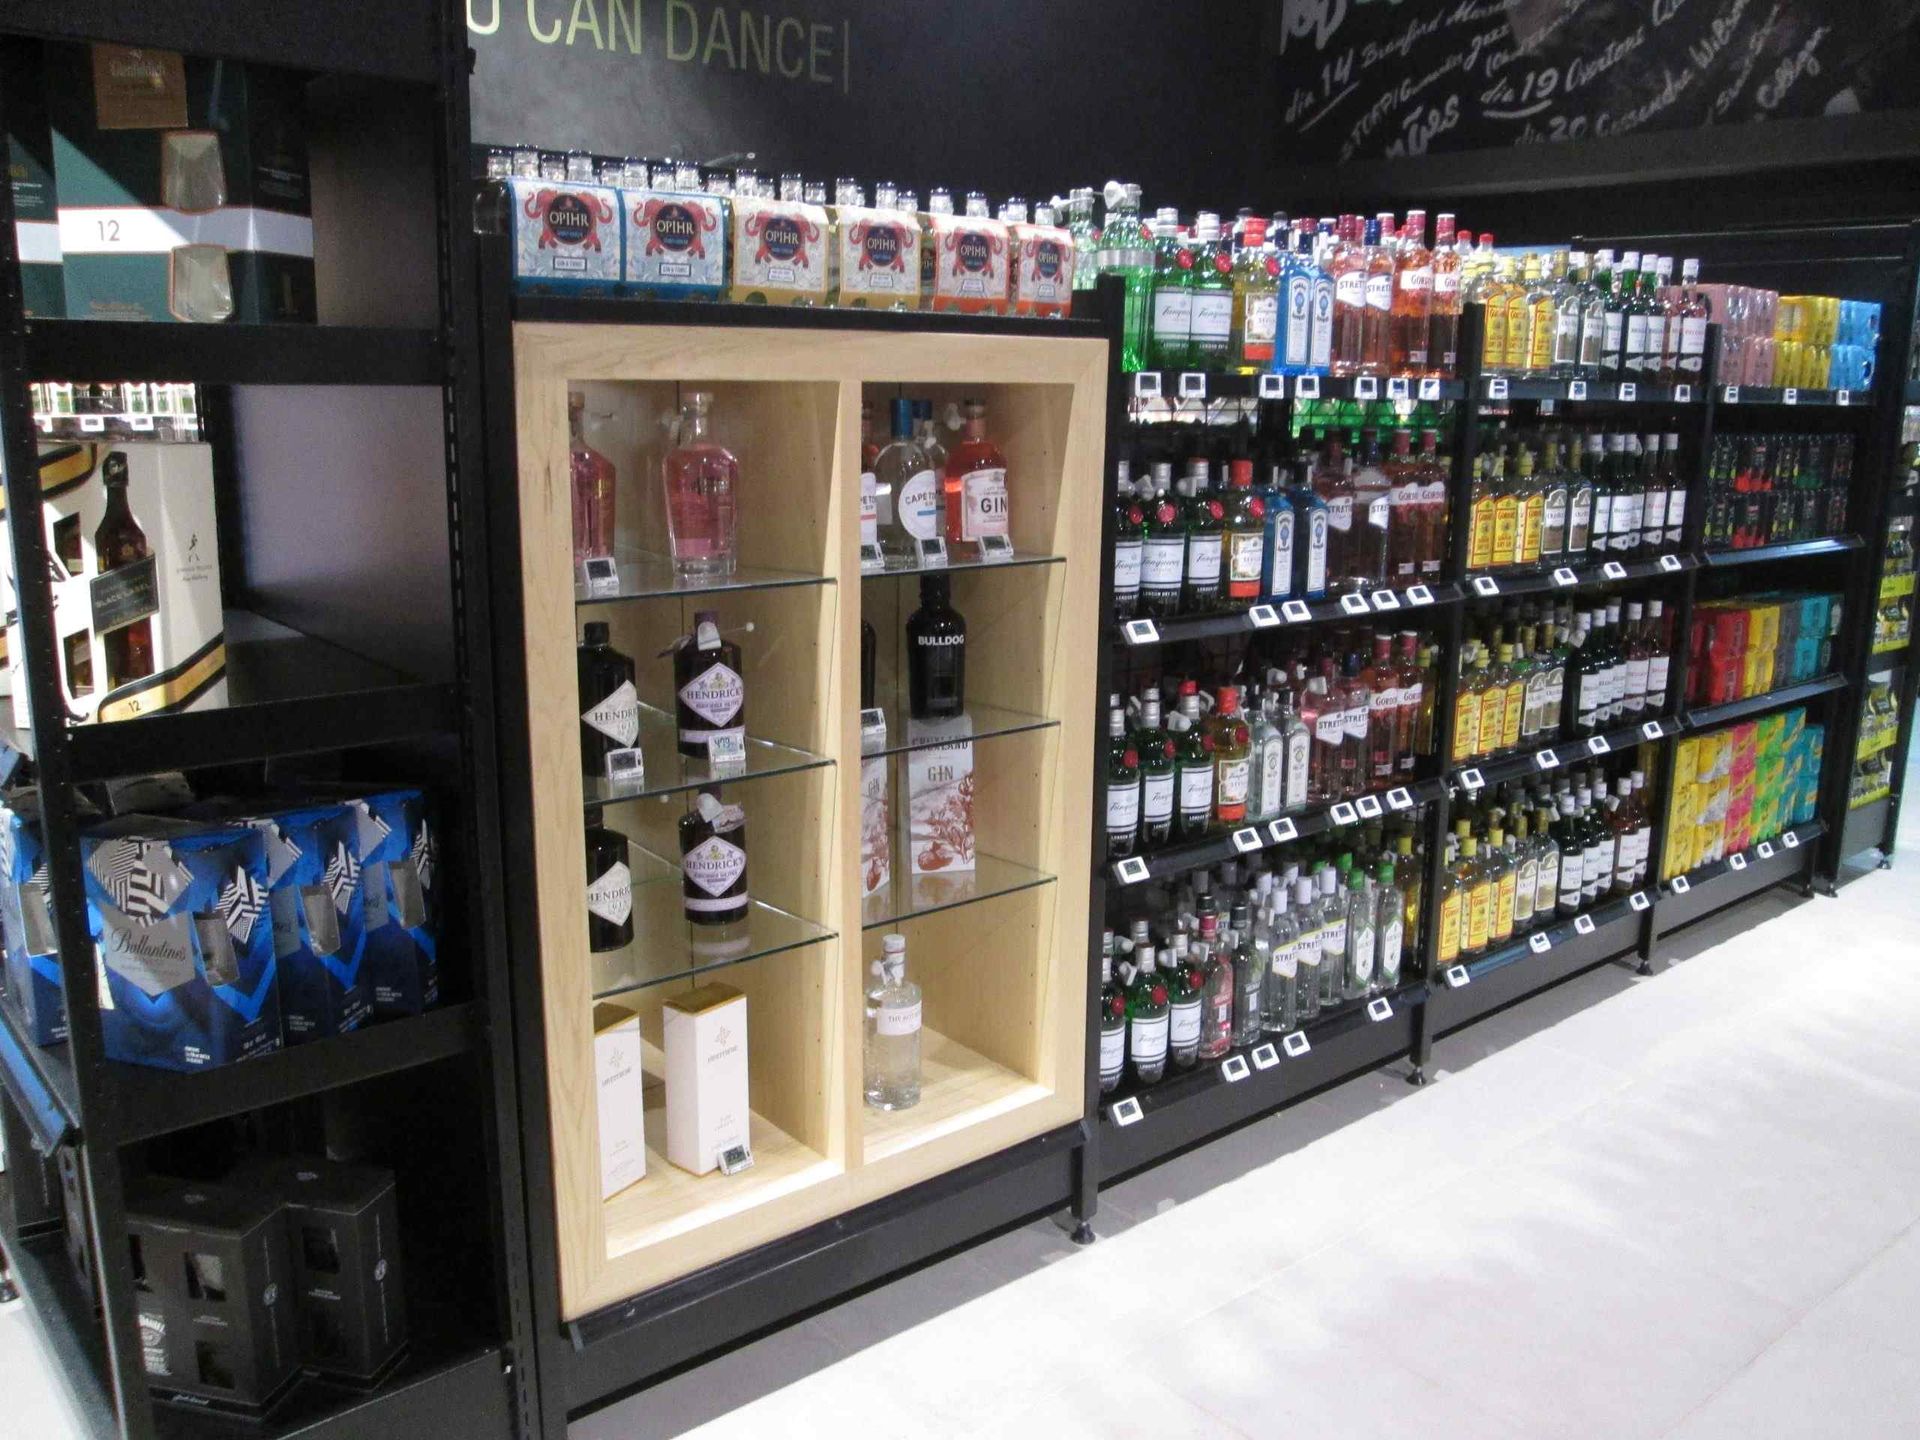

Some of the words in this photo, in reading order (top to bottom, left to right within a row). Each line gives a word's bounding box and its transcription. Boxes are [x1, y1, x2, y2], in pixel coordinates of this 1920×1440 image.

[527, 0, 642, 54] CAN
[666, 0, 833, 83] DANCE
[1521, 67, 1559, 99] 19
[1547, 113, 1587, 144] 20
[549, 211, 590, 227] OPIHR
[655, 219, 695, 234] OPIHR
[97, 220, 121, 242] 12
[765, 229, 799, 245] OPIHR
[867, 237, 897, 250] OPIHR
[981, 496, 1007, 514] GIN
[917, 633, 965, 646] BULLDOG
[128, 700, 142, 713] 12
[927, 765, 954, 781] GIN
